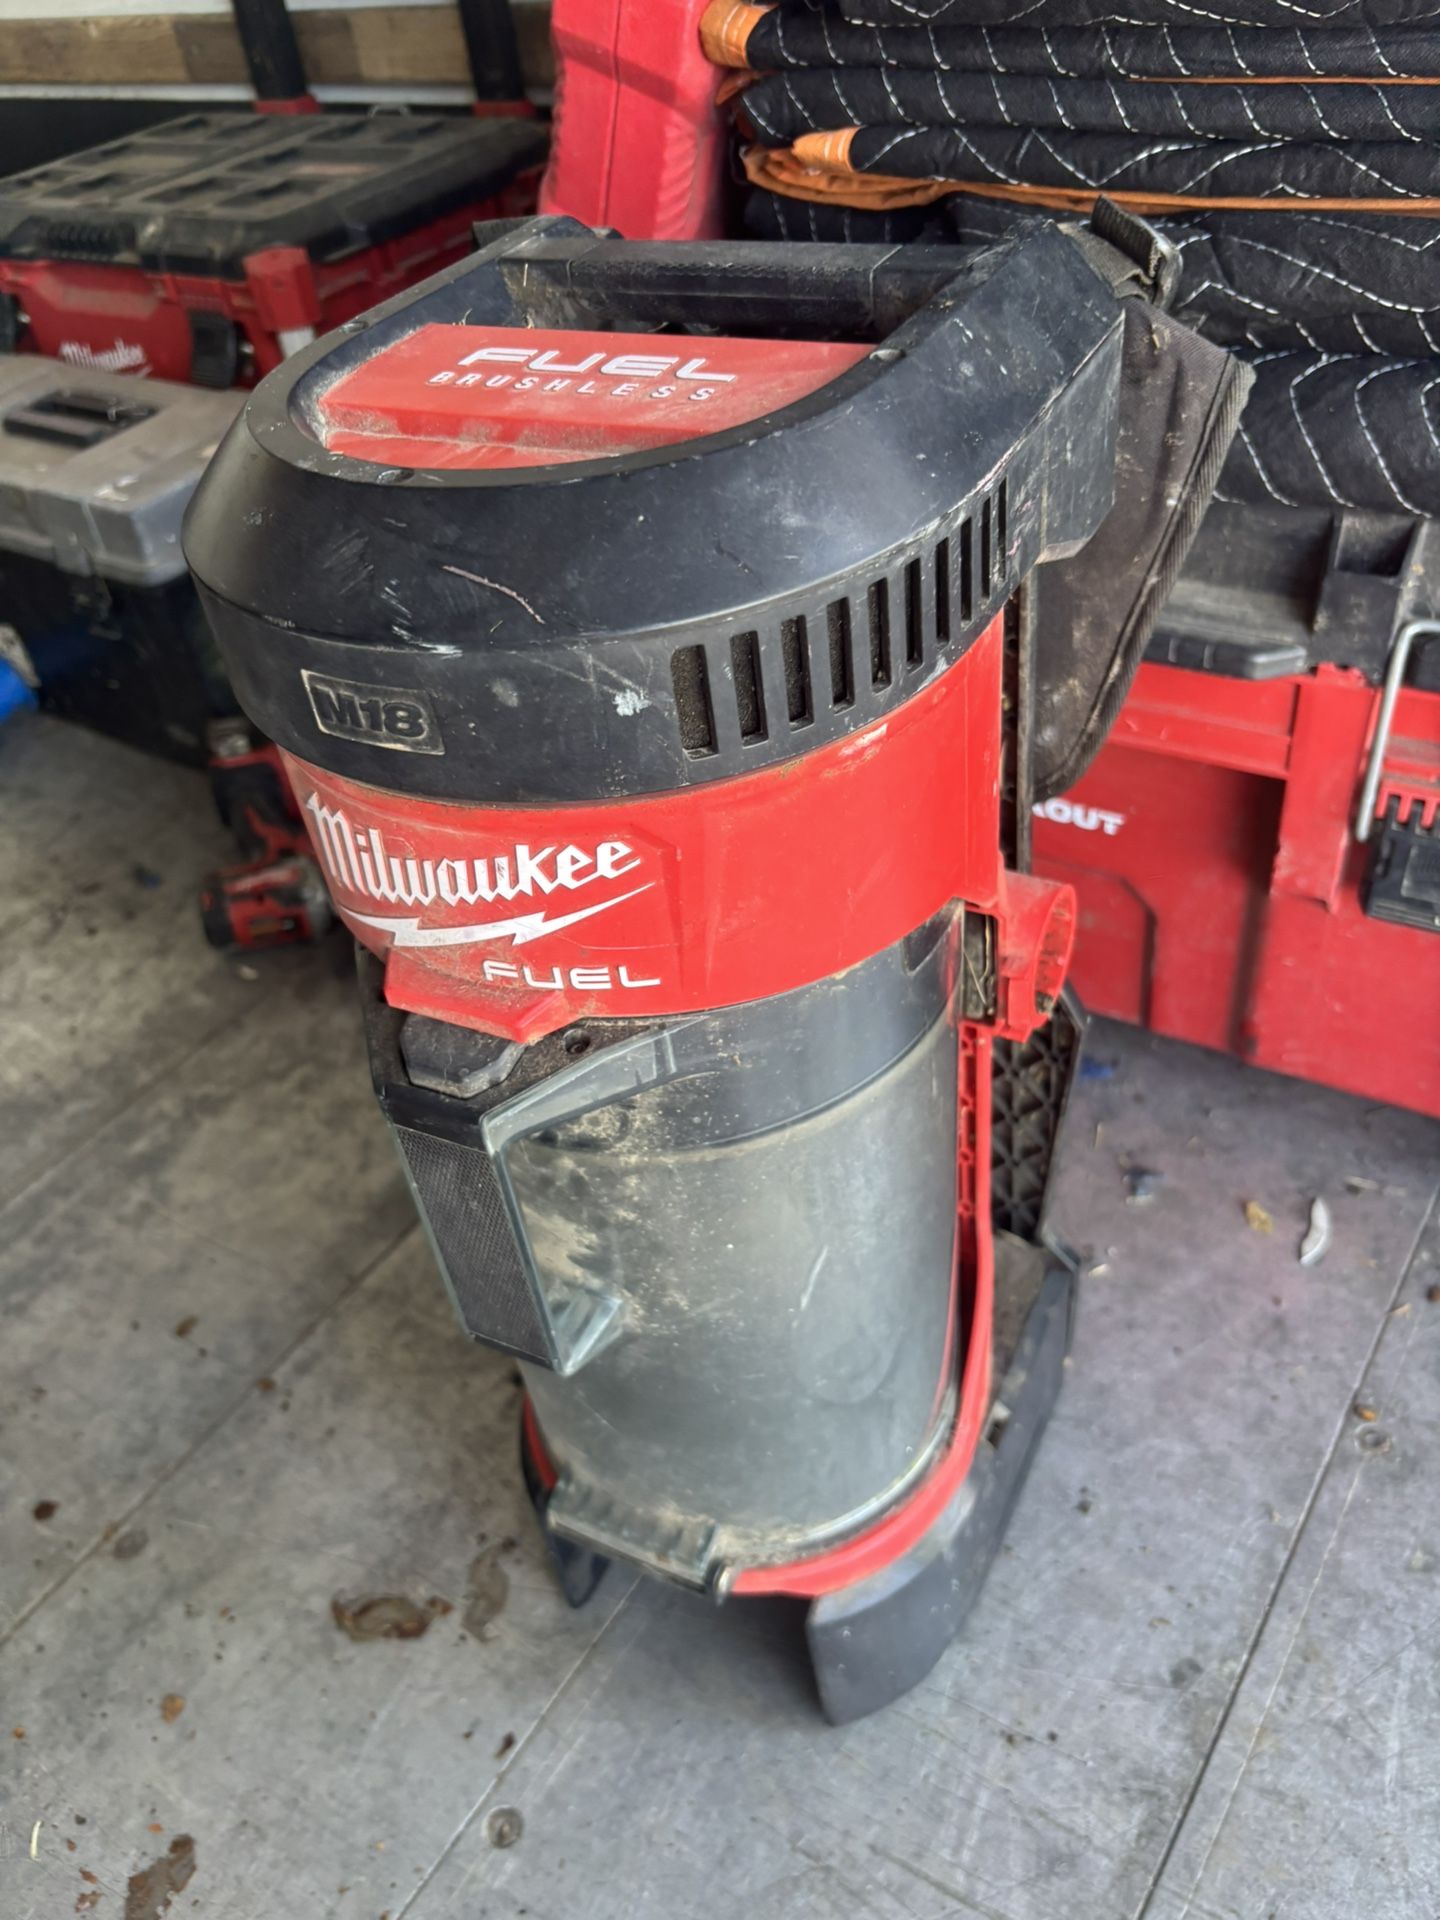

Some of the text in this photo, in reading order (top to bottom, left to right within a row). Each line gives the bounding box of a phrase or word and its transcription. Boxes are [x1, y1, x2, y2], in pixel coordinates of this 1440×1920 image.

[457, 346, 738, 383] FUEL
[426, 370, 716, 401] BRUSHLESS
[313, 683, 428, 740] M18
[306, 791, 642, 907] Milwaukee
[482, 958, 662, 990] FUEL
